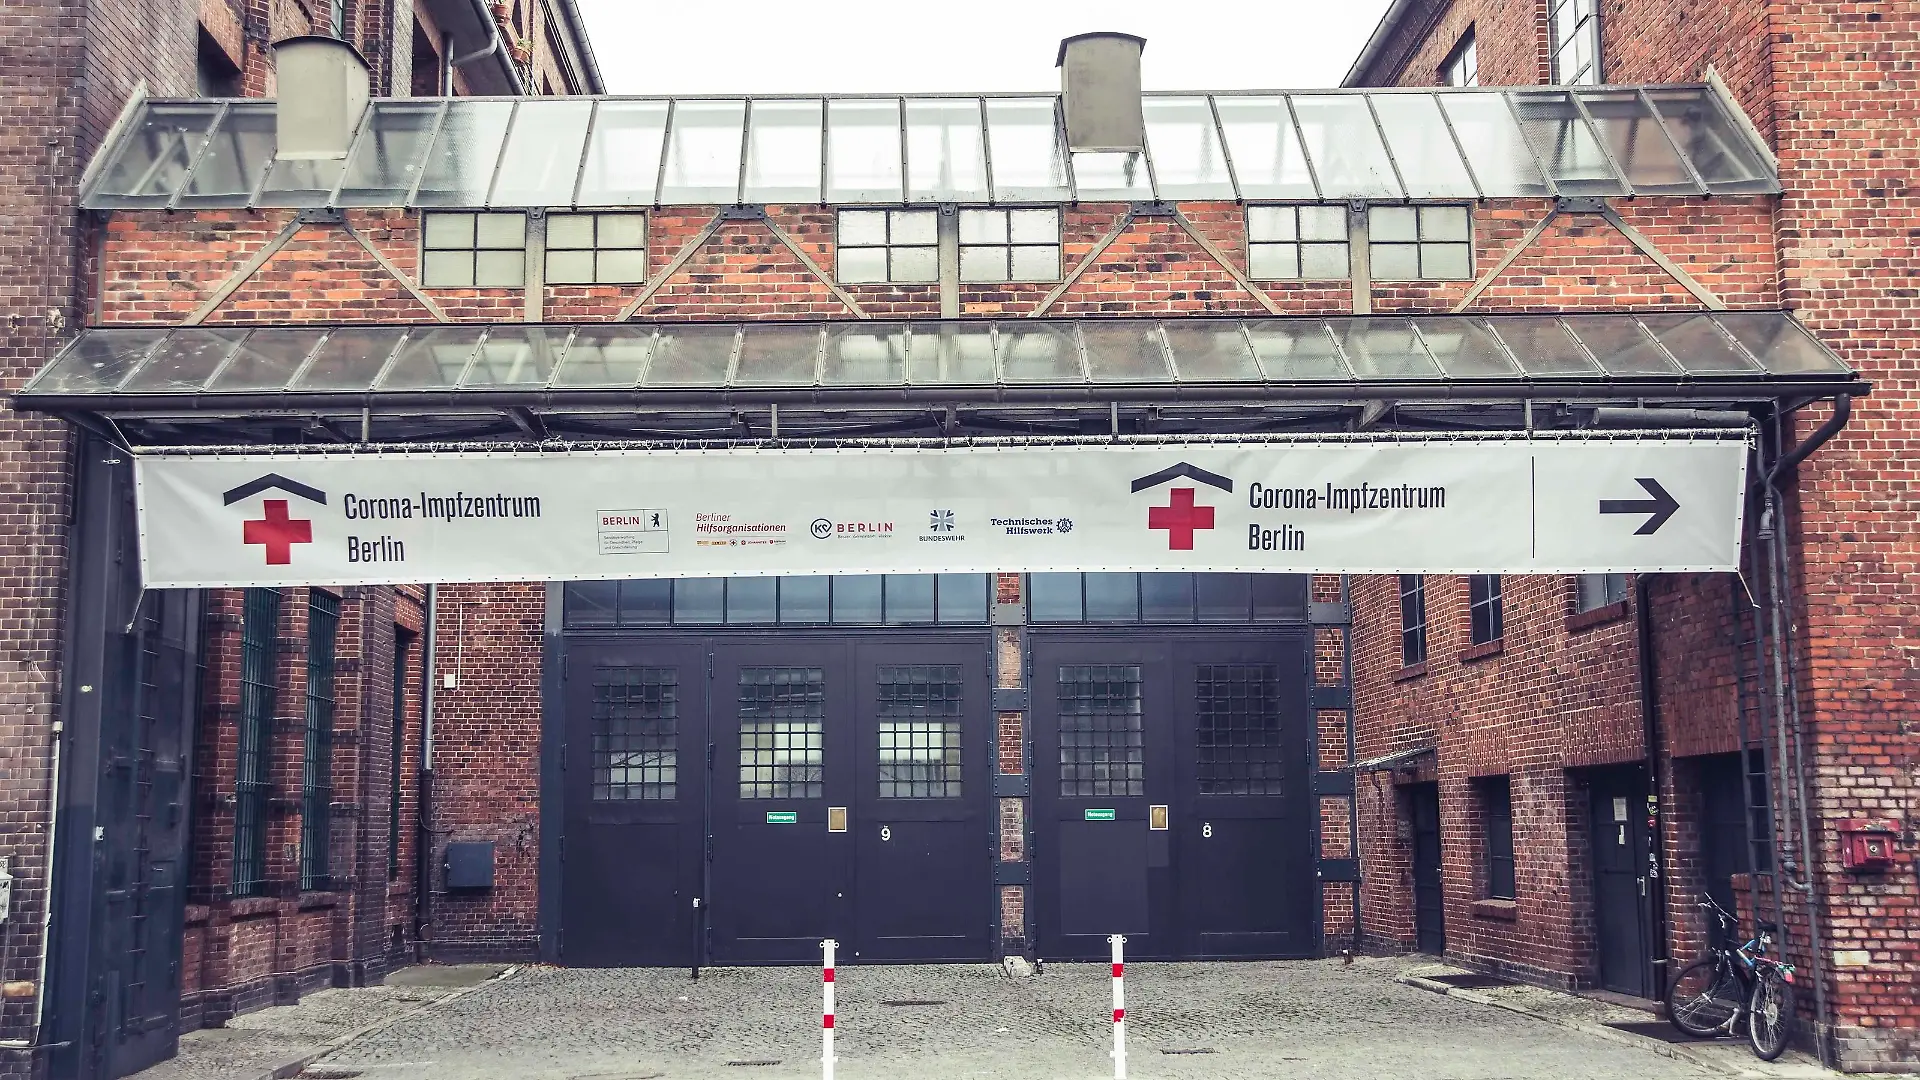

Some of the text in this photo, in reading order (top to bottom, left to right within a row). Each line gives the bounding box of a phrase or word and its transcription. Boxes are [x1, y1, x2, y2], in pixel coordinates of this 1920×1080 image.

[1249, 481, 1446, 513] Corona-Impfzentrum
[344, 491, 541, 523] Corona-Impfzentrum
[602, 516, 640, 526] BERLIN
[695, 512, 731, 522] Berliner
[990, 517, 1053, 526] Technisches
[696, 523, 786, 534] Hilfsorganisationen
[837, 522, 893, 533] BERLIN
[1006, 526, 1053, 535] Hilfswerk
[919, 534, 965, 542] BUNDESWEHR
[1249, 523, 1305, 551] Berlin
[347, 535, 405, 563] Berlin
[881, 827, 891, 841] 9
[1202, 824, 1213, 838] 8
